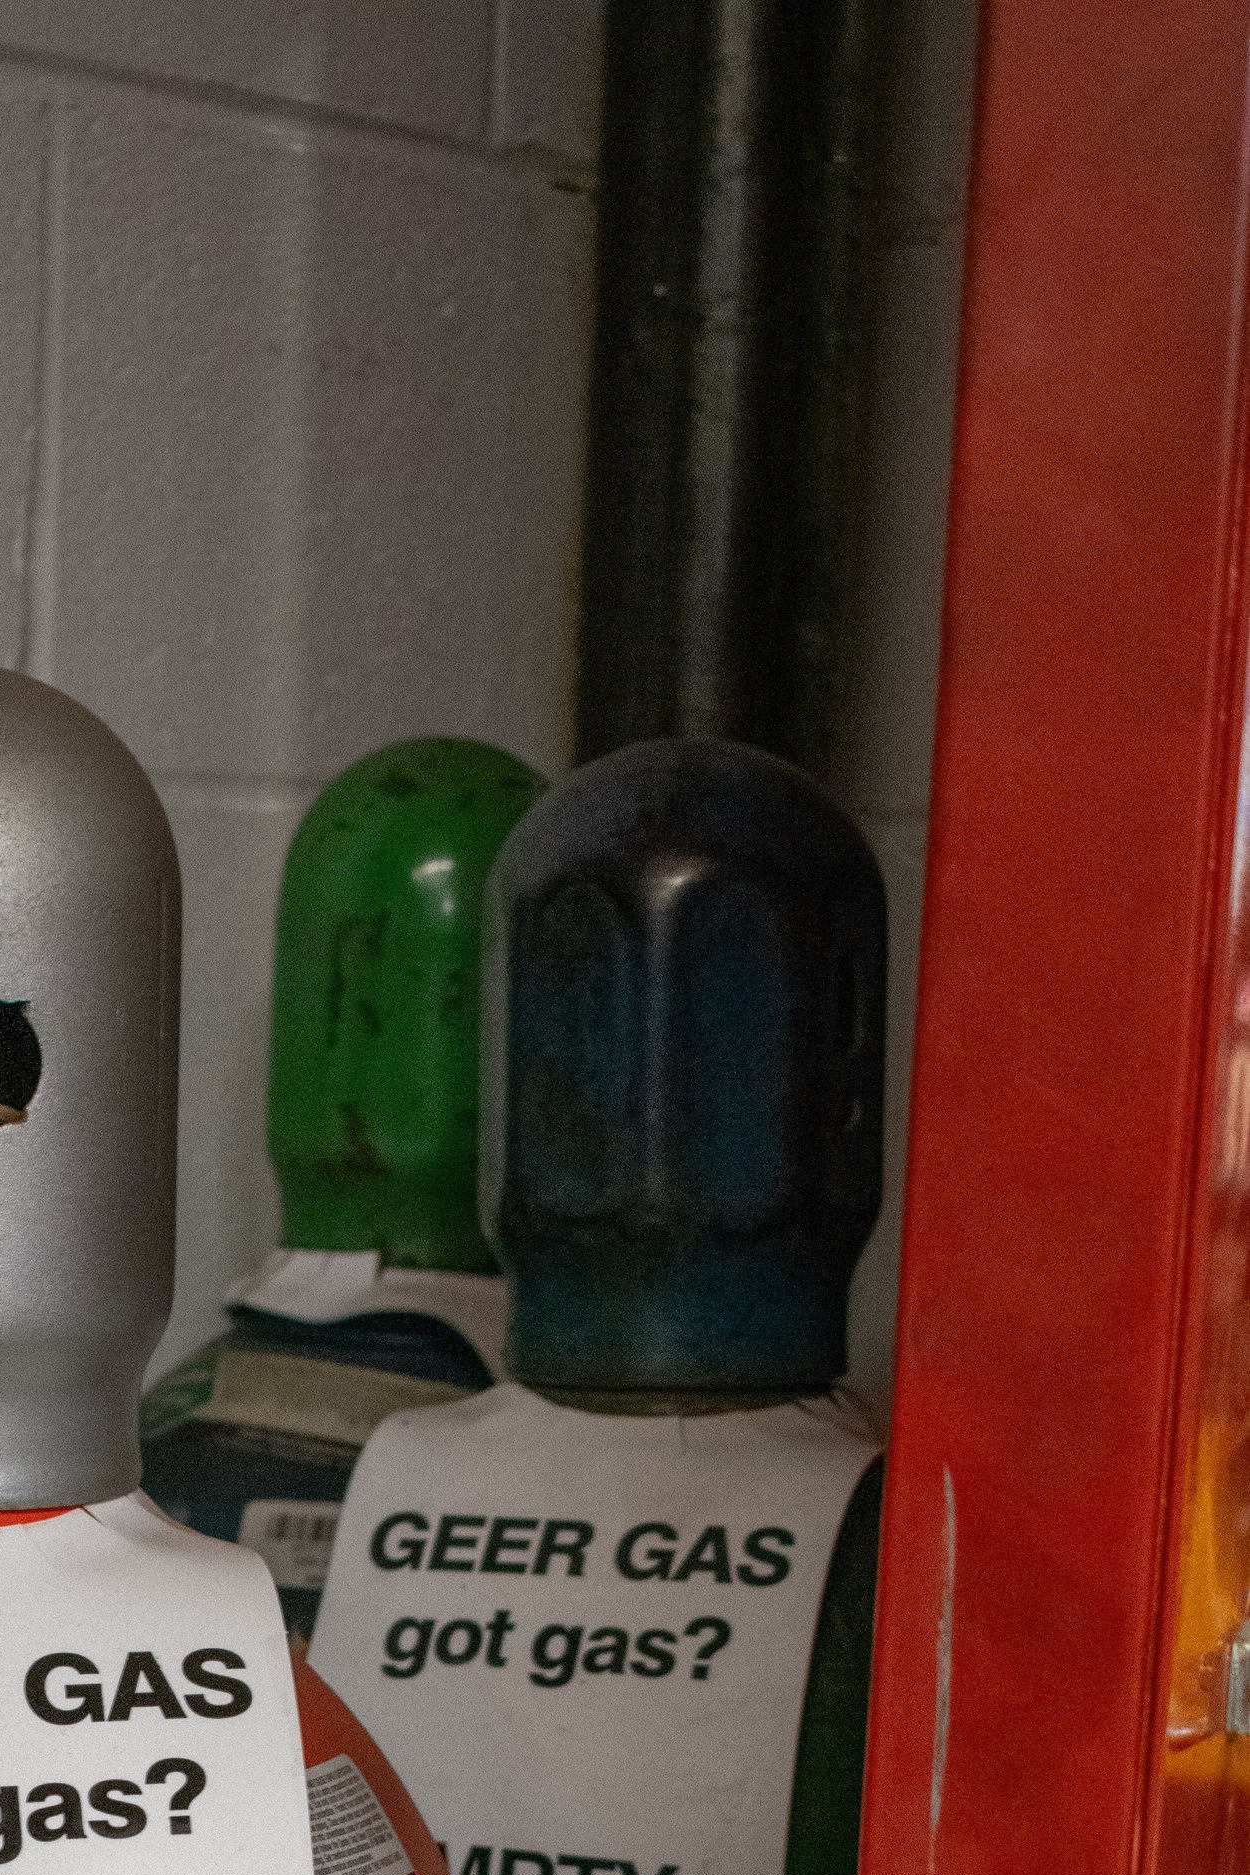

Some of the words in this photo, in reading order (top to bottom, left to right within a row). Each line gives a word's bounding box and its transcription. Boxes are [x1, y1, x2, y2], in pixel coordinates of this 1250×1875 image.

[369, 1511, 595, 1577] GEER
[614, 1522, 796, 1586] GAS
[23, 1648, 253, 1726] GAS
[381, 1610, 515, 1679] got
[529, 1616, 731, 1688] gas?
